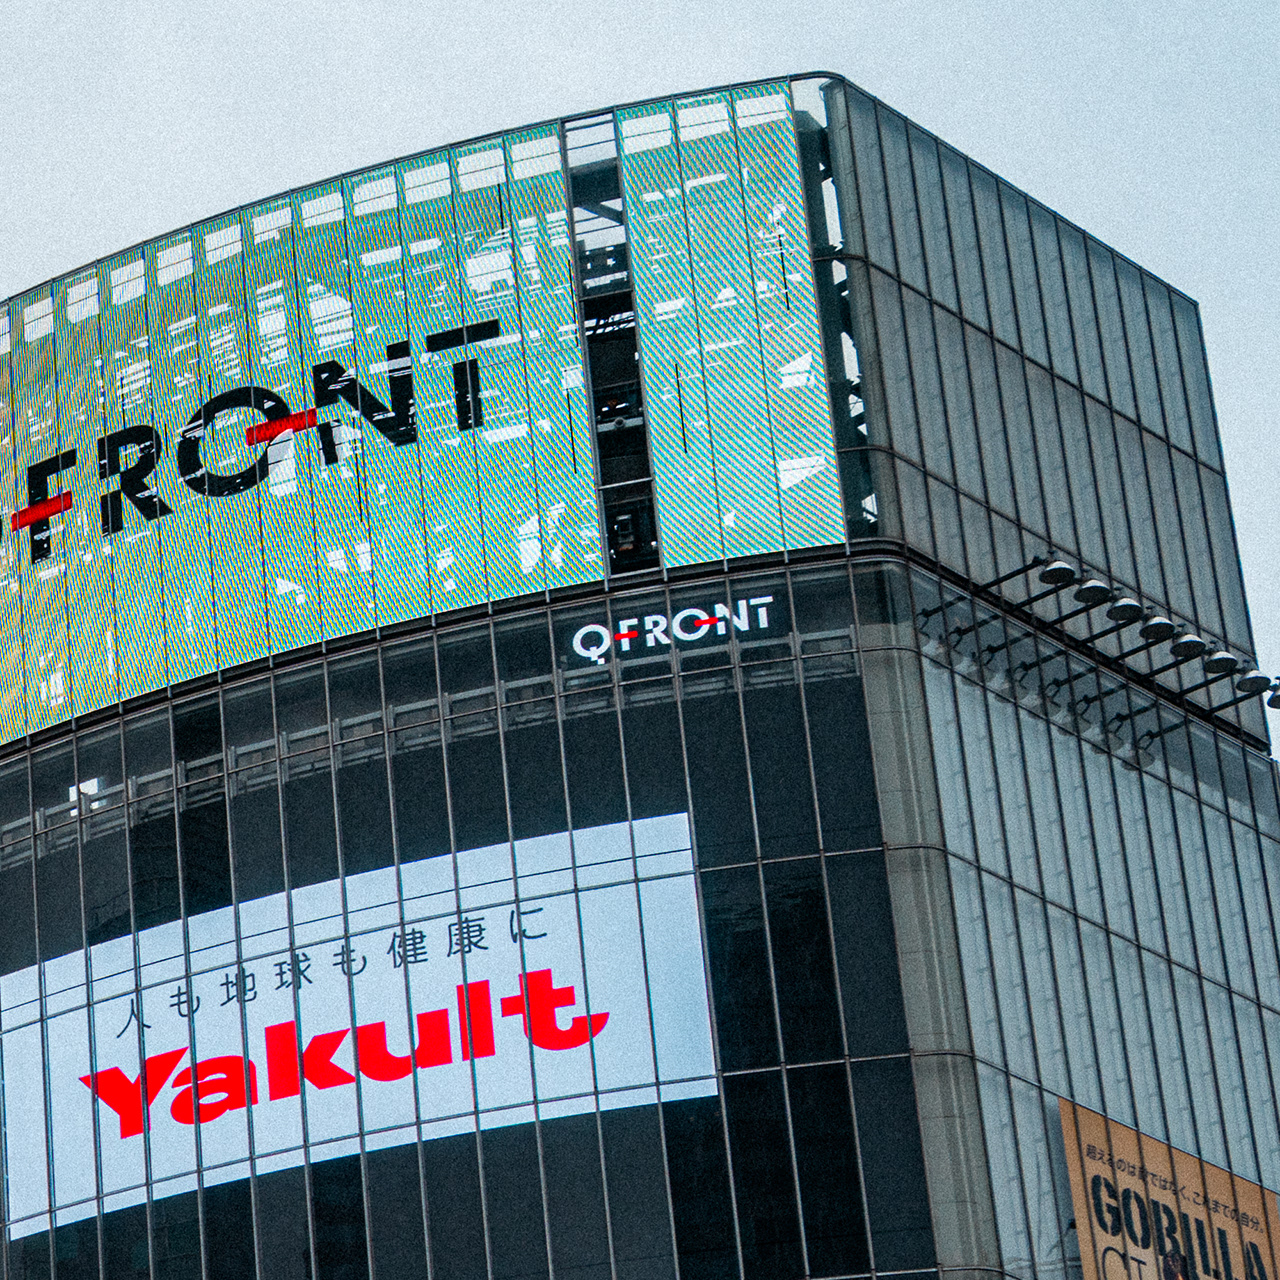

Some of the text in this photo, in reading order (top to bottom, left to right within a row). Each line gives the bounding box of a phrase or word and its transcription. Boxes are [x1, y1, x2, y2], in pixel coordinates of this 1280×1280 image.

[573, 595, 773, 665] QFRONT
[116, 906, 548, 1039] 人も地球も健康に
[79, 968, 610, 1140] Yakult
